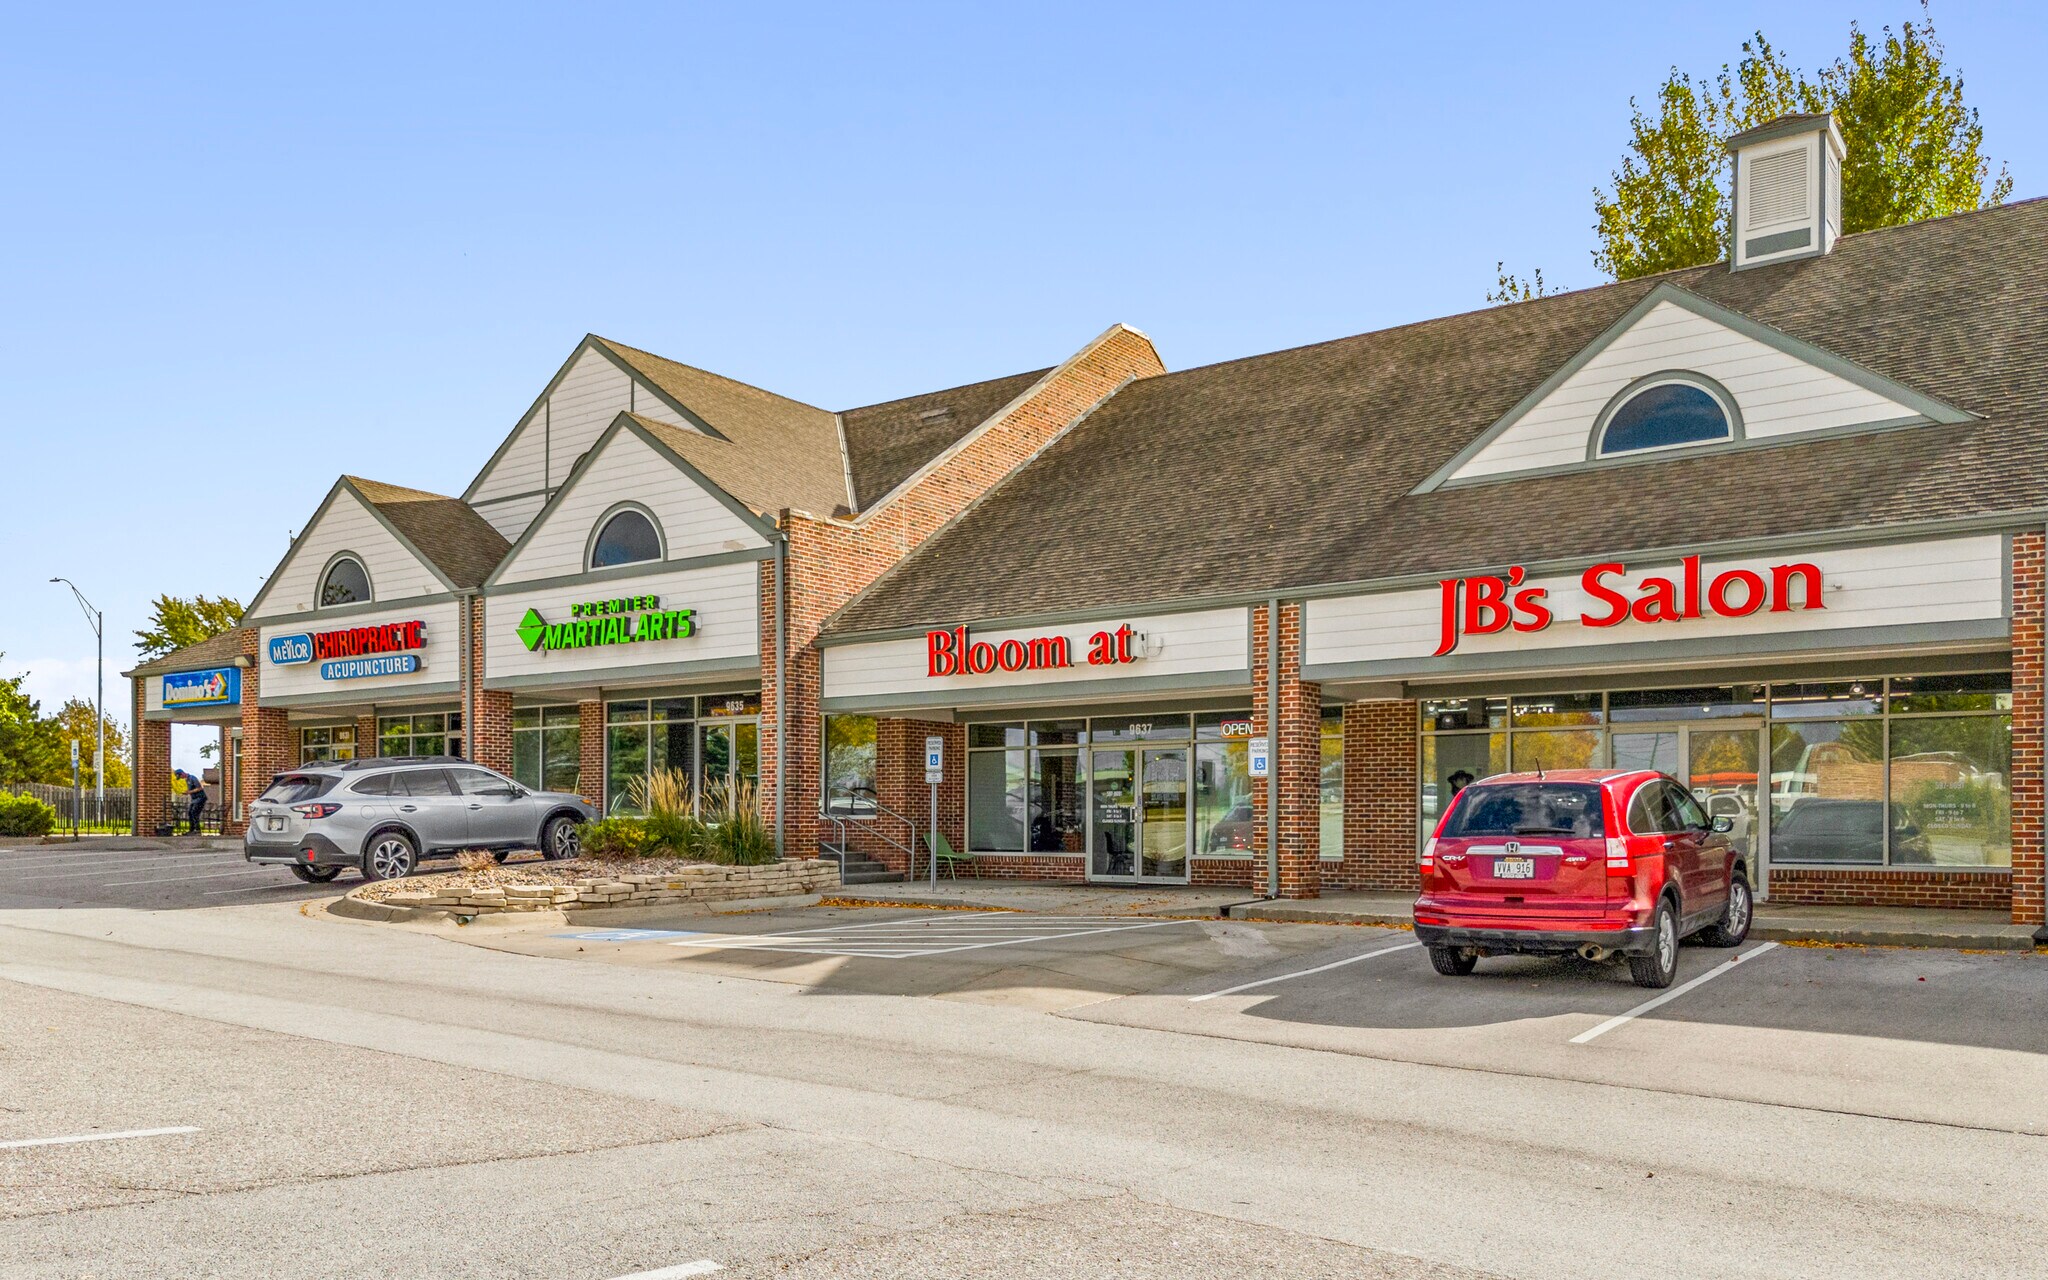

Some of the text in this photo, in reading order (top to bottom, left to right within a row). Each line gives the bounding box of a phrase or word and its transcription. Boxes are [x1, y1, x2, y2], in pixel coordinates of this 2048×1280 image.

[571, 595, 656, 617] PREMIER
[1432, 554, 1828, 657] JB's Salon
[315, 620, 421, 659] CHIROPRACTIC
[544, 609, 692, 650] MARTIAL ARTS
[273, 639, 309, 661] MEYLOR
[925, 623, 1138, 677] Bloom at
[327, 657, 409, 679] ACUPUNCTURE
[165, 679, 212, 701] Domino's
[726, 700, 744, 711] 9635
[1222, 723, 1254, 736] OPEN
[1497, 863, 1531, 873] VVA 916
